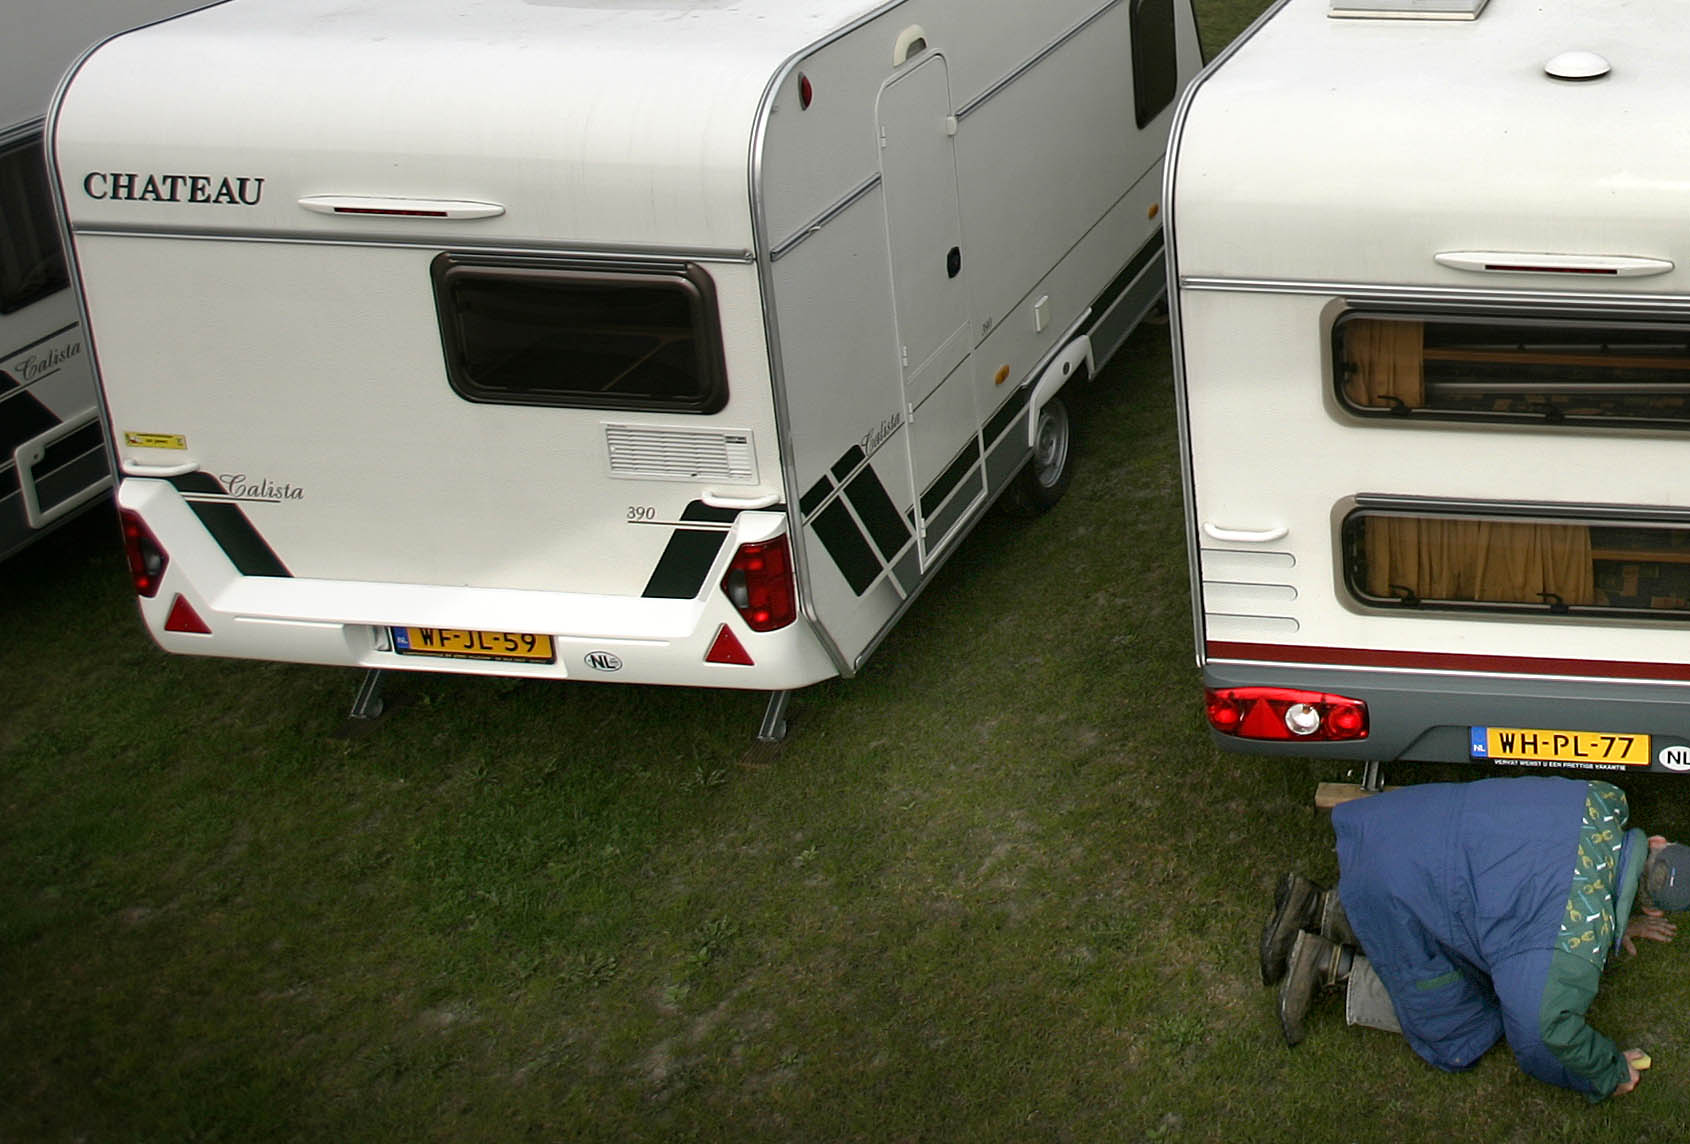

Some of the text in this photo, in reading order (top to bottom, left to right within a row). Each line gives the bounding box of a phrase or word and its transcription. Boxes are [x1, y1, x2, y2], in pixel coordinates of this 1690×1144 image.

[83, 171, 265, 206] CHATEAU
[15, 341, 82, 381] Calista
[219, 474, 305, 501] Calista
[626, 506, 656, 522] 390
[419, 627, 537, 653] WF-JL-59
[590, 654, 617, 669] NL
[1473, 744, 1486, 753] NL
[1499, 732, 1635, 759] WH-PL-77
